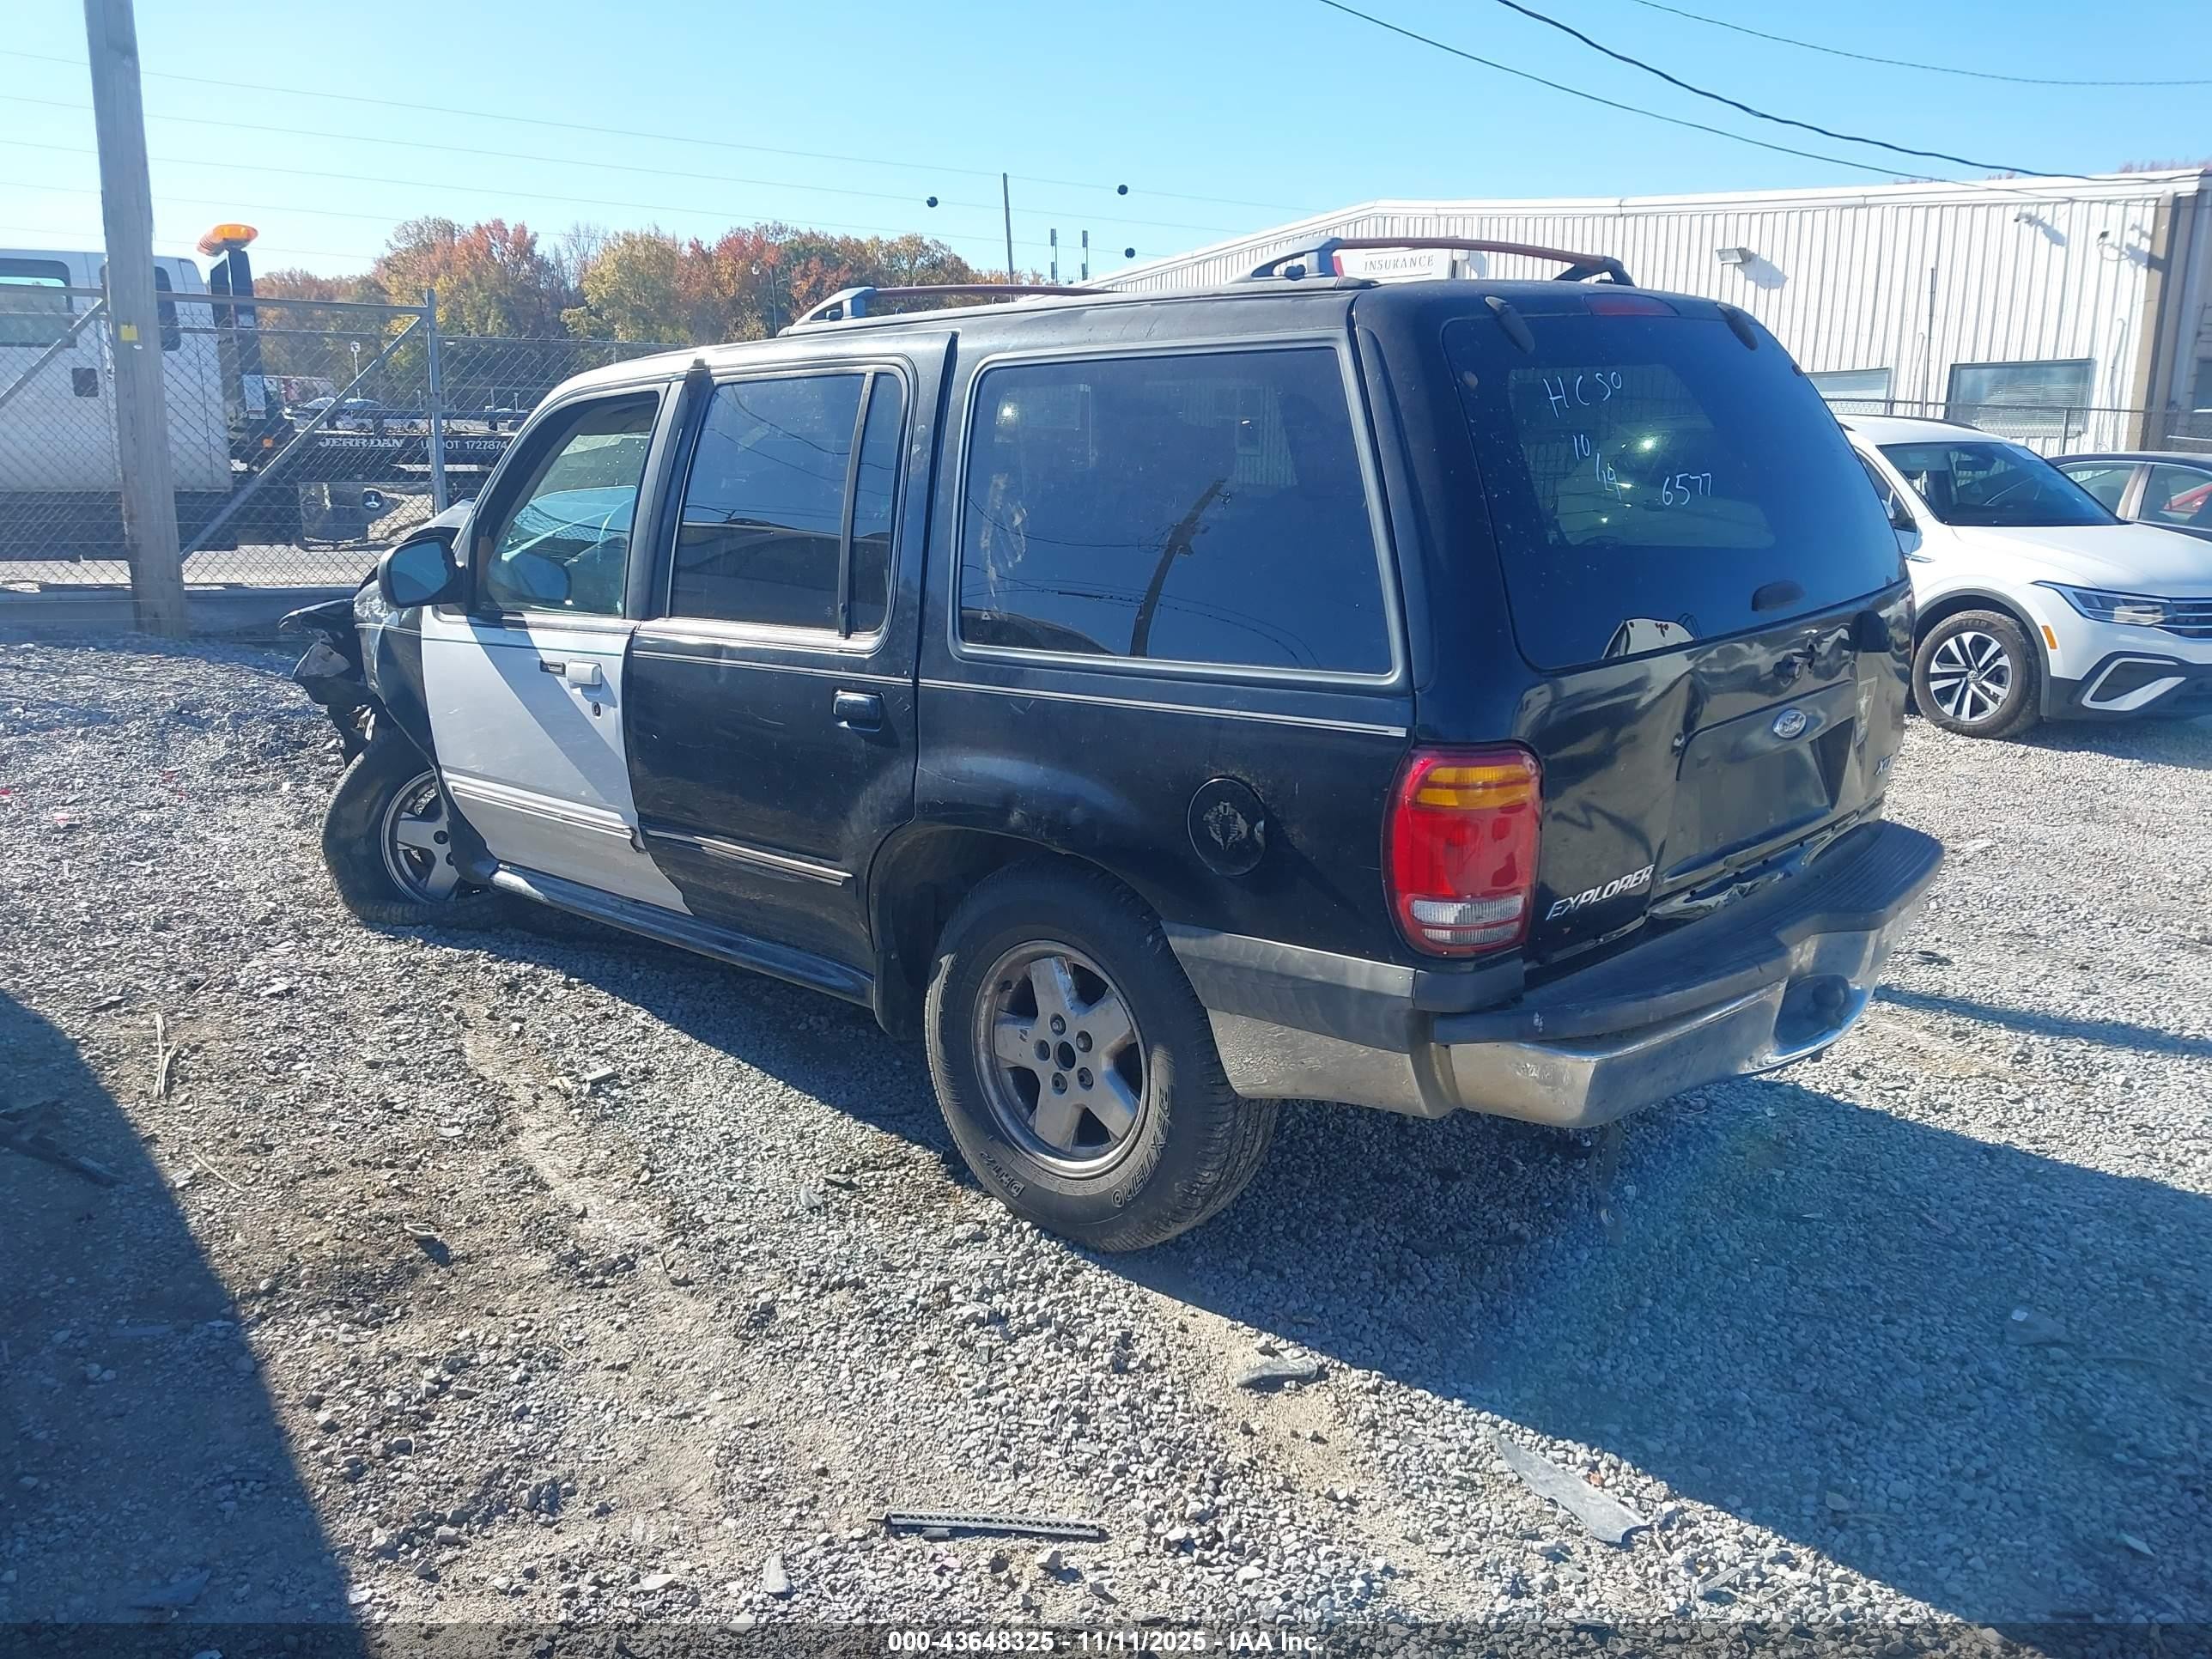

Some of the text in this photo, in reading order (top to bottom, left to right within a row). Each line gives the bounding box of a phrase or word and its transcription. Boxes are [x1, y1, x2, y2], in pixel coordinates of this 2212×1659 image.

[1364, 254, 1434, 271] INSURANCE
[1662, 473, 1711, 505] 6577
[1546, 864, 1655, 921] EXPLORER
